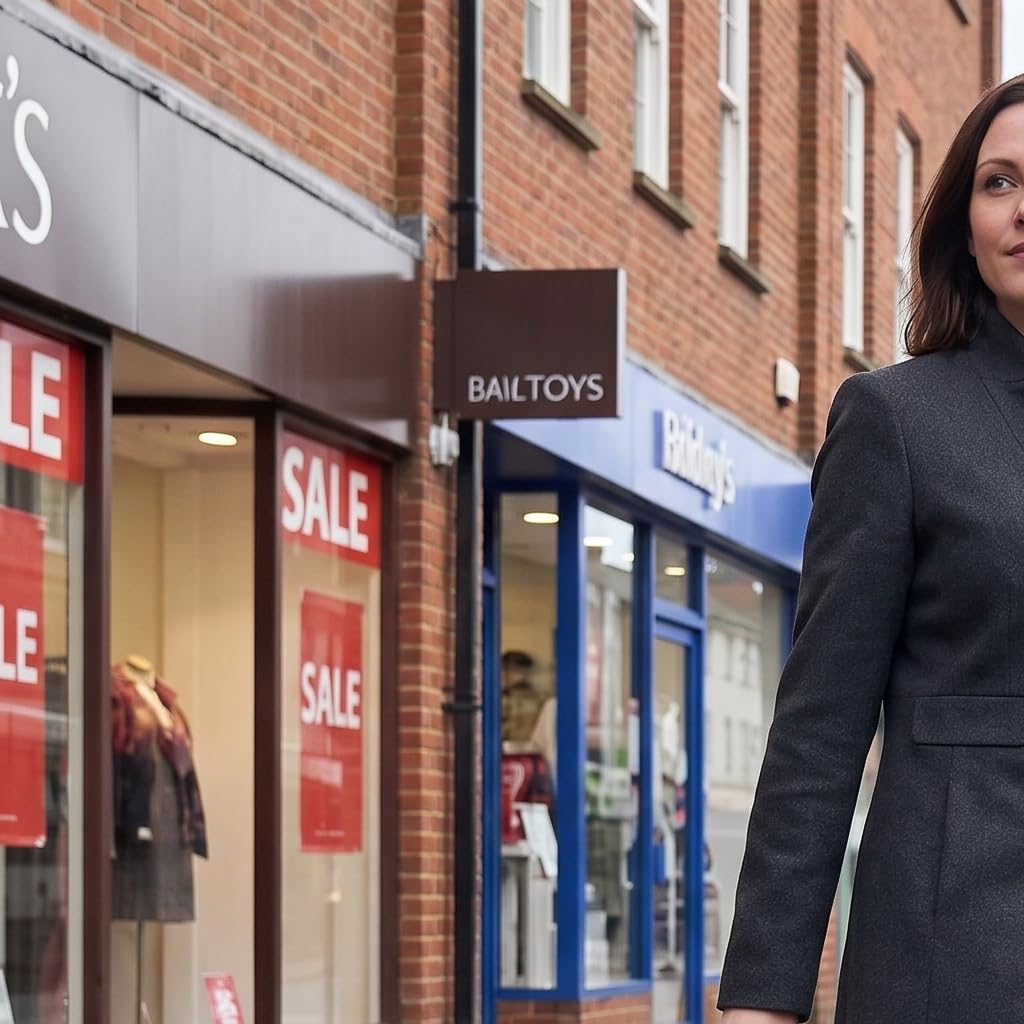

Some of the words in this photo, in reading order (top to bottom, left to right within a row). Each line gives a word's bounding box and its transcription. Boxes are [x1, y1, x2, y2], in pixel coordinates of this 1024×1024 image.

[468, 373, 604, 402] BAILTOYS
[281, 445, 369, 553] SALE
[301, 661, 361, 730] SALE
